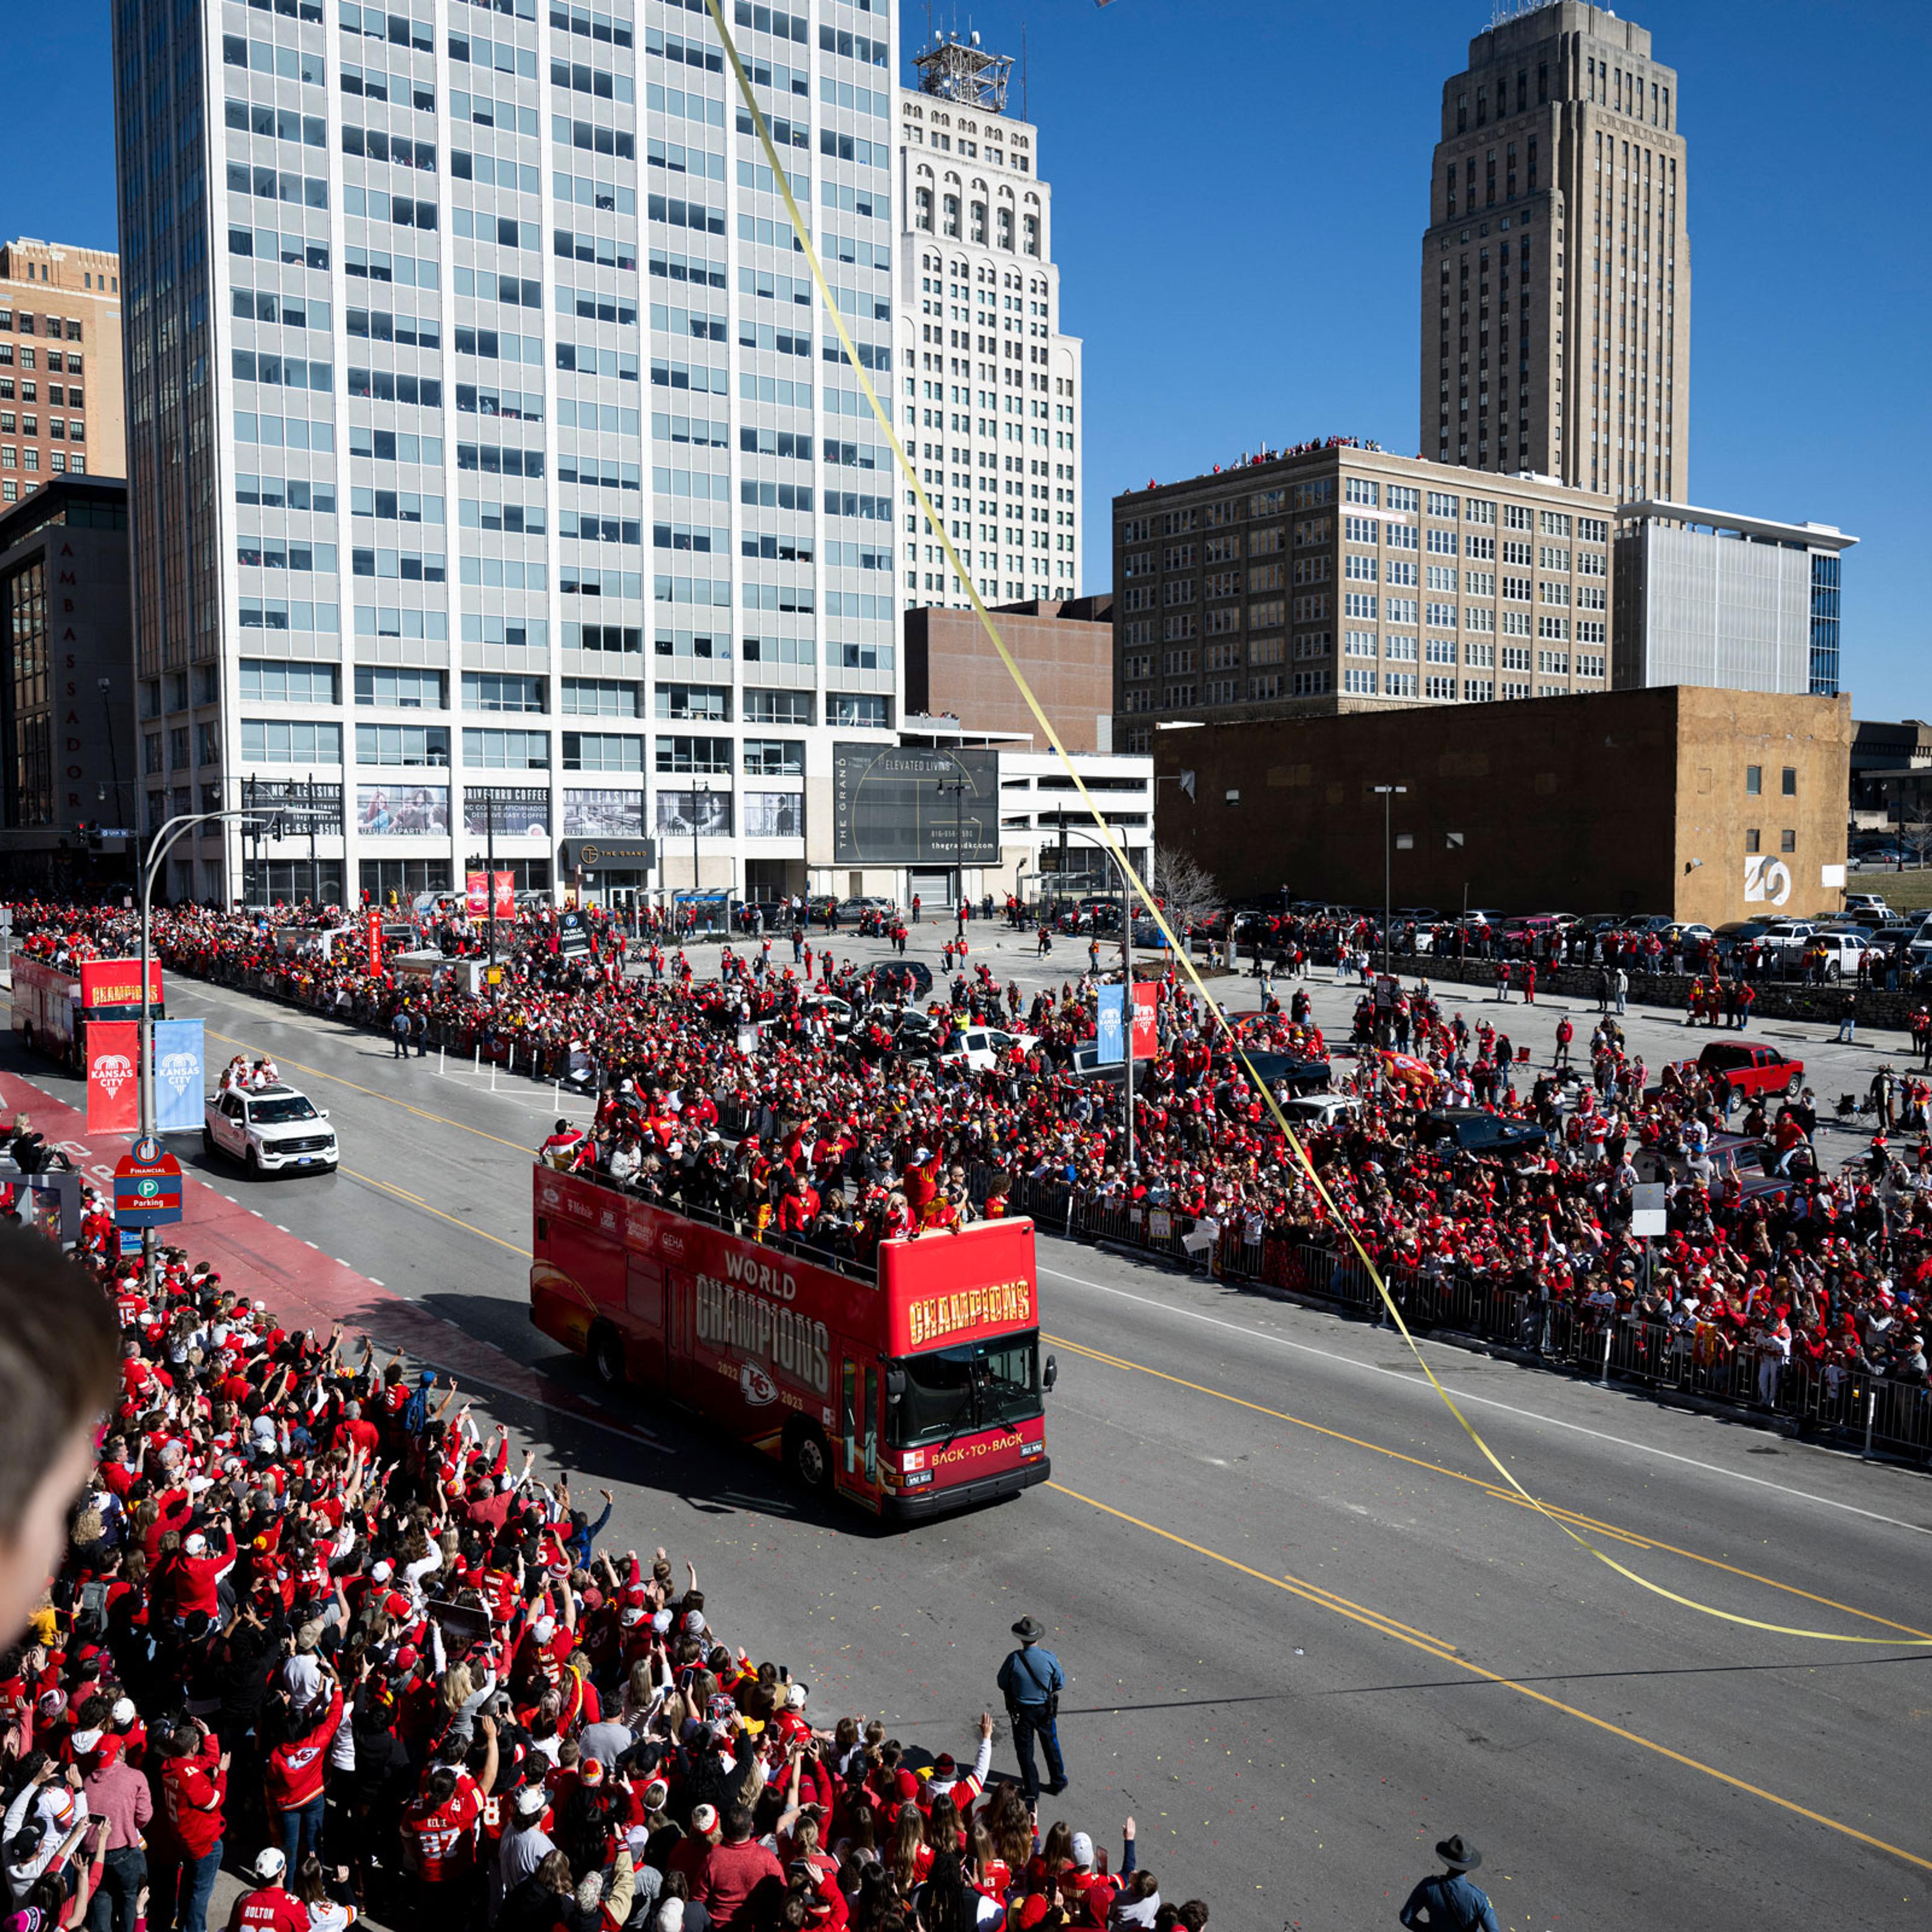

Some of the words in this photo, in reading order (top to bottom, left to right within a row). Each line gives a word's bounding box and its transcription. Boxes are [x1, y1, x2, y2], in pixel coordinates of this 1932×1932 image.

[59, 542, 83, 808] AMBASSADOR
[886, 760, 924, 771] ELEVATED
[839, 758, 847, 811] GRAND
[515, 788, 548, 801] COFFEE
[839, 820, 847, 849] THE
[562, 933, 587, 941] PARKING
[563, 927, 584, 935] PUBLIC
[92, 984, 158, 1006] CHAMPIOS
[91, 1069, 133, 1079] KANSAS
[159, 1067, 200, 1077] KANSAS
[169, 1076, 192, 1085] CITY
[100, 1078, 124, 1087] CITY
[133, 1198, 164, 1208] Parking
[662, 1233, 684, 1251] GEHA
[725, 1249, 796, 1301] WORLD
[909, 1279, 1031, 1345] CHAMPIONS
[696, 1273, 829, 1394] CHAMPIONS
[717, 1360, 739, 1381] 2022
[781, 1390, 803, 1410] 2023
[419, 1827, 461, 1860] 87
[244, 1905, 275, 1920] BOLTON
